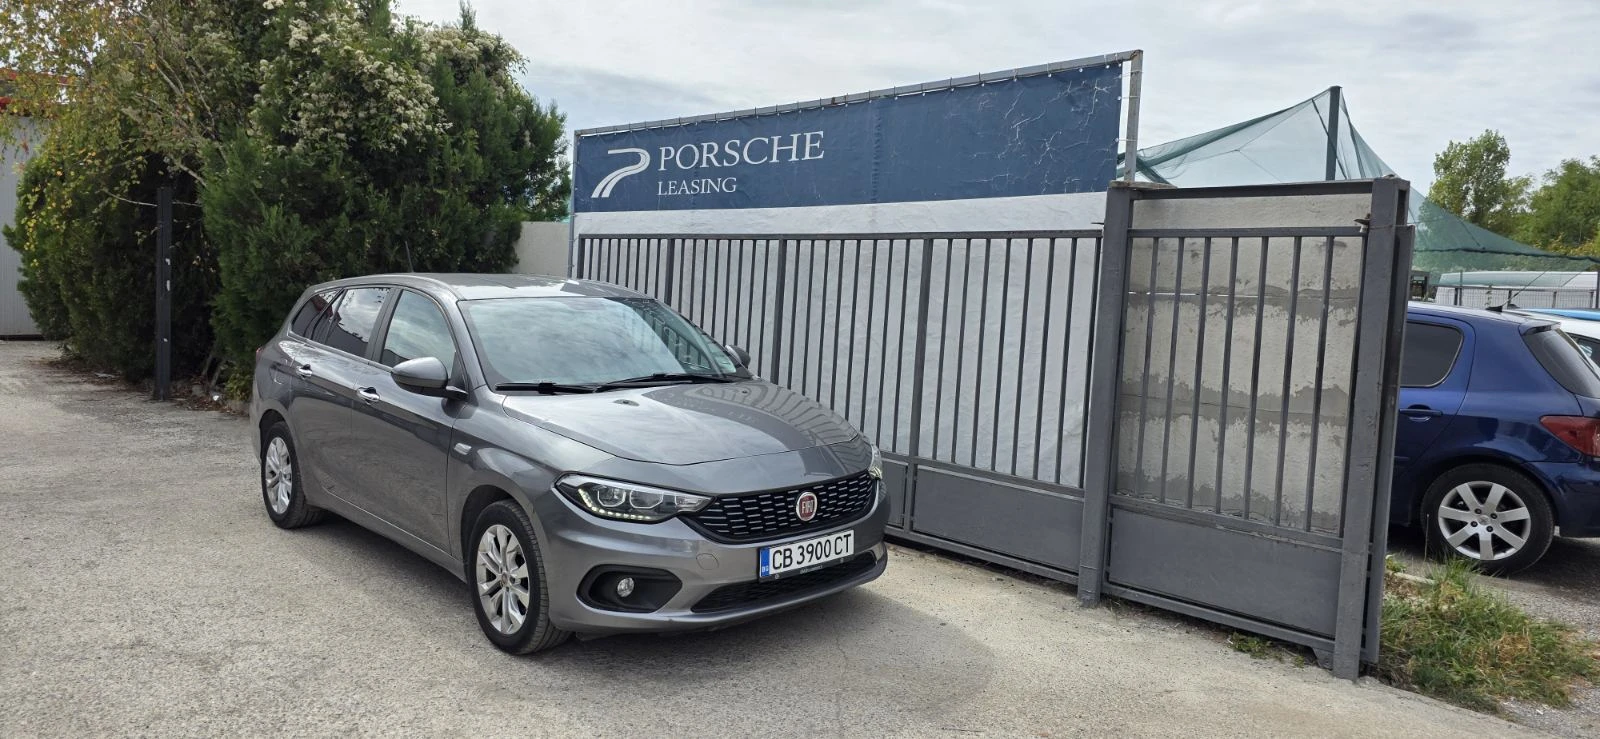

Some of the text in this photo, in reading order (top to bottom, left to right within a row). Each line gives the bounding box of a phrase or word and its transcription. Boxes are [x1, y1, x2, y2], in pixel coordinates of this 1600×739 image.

[658, 131, 825, 171] PORSCHE
[657, 177, 737, 196] LEASING
[773, 548, 793, 570] CB
[796, 540, 831, 565] 3900
[834, 534, 851, 555] CT
